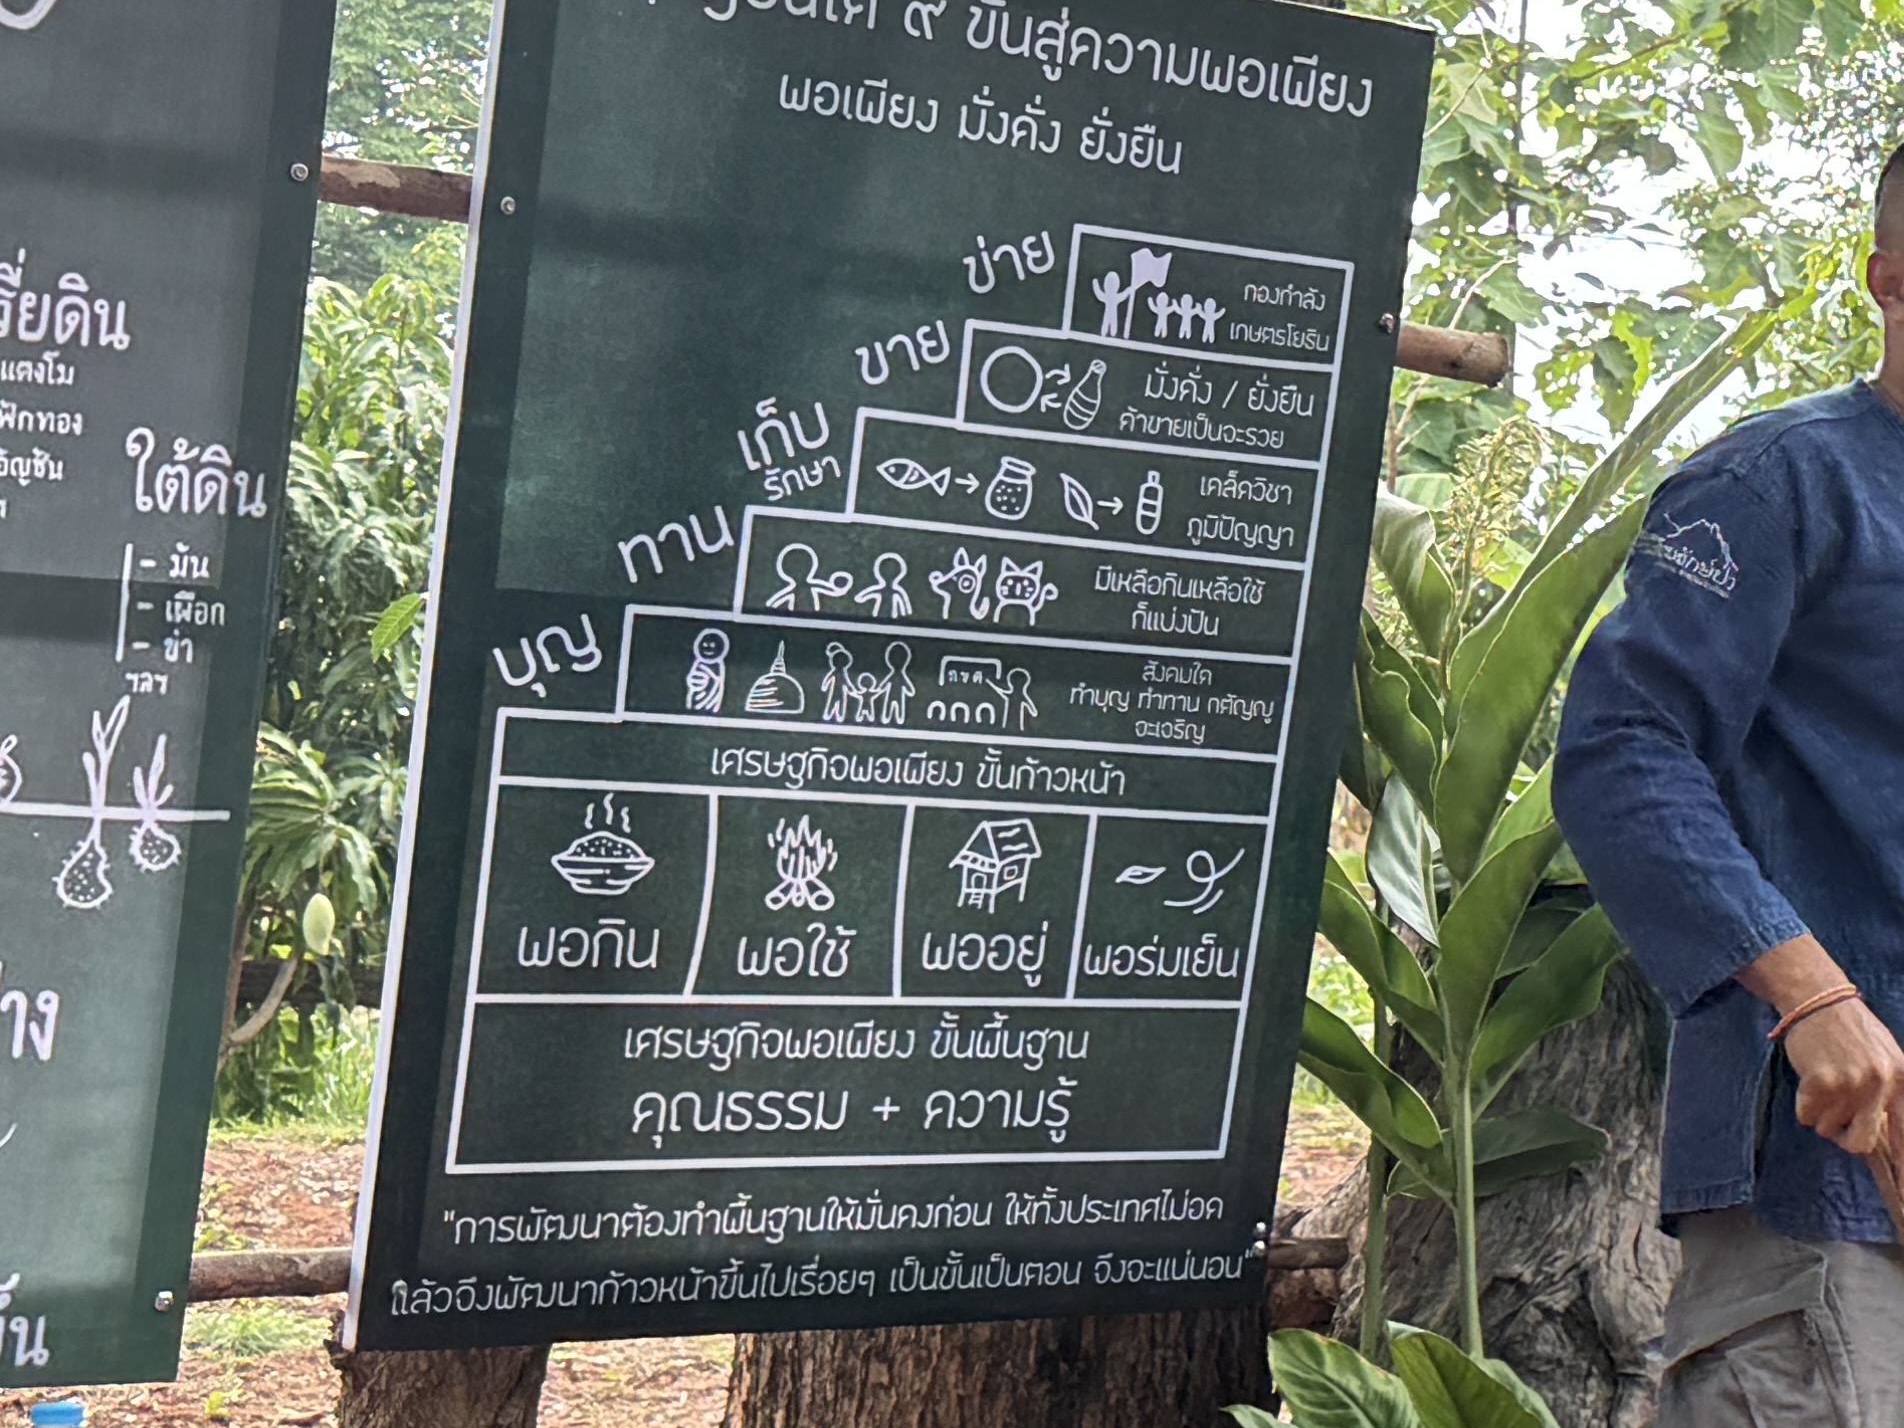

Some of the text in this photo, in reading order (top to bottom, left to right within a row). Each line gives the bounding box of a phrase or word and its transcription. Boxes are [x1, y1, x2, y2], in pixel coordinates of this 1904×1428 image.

[778, 72, 1184, 175] พอเพียง มั่งคั่ง ยั่งยืน
[963, 231, 1056, 294] ข่าย
[1243, 283, 1327, 313] กองกำลัง
[855, 320, 950, 385] ขาย
[1143, 360, 1213, 406] มั่งคั่ง
[1247, 374, 1315, 418] ยั่งยืน
[737, 396, 830, 471] เก็บ
[1119, 405, 1286, 450] ค้าขายเป็นจะรวย
[124, 426, 268, 518] ใต้ดิน
[763, 455, 842, 502] รักษา
[617, 504, 735, 584] ทาน
[1186, 513, 1296, 551] ภูมิปัญญา
[1093, 563, 1264, 607] มีเหลือกินเหลือใช้
[1130, 602, 1221, 638] ก็แบ่งปัน
[492, 612, 604, 699] บุญ
[1069, 681, 1131, 714] ทำบุญ
[1137, 685, 1200, 714] ทำทาน
[710, 742, 1127, 797] เศรษฐกิจพอเพียง ขั้นก้าวหน้า
[517, 916, 1241, 988] พอกิน พอใช้ พออยู่ พอร่มเย็น
[623, 1011, 1090, 1072] เศรษฐกิจพอเพียง ขั้นพื้นฐาน
[631, 1076, 1079, 1151] คุณธรรม + ความรู้
[889, 1245, 1082, 1297] เป็นขั้นเป็นตอน
